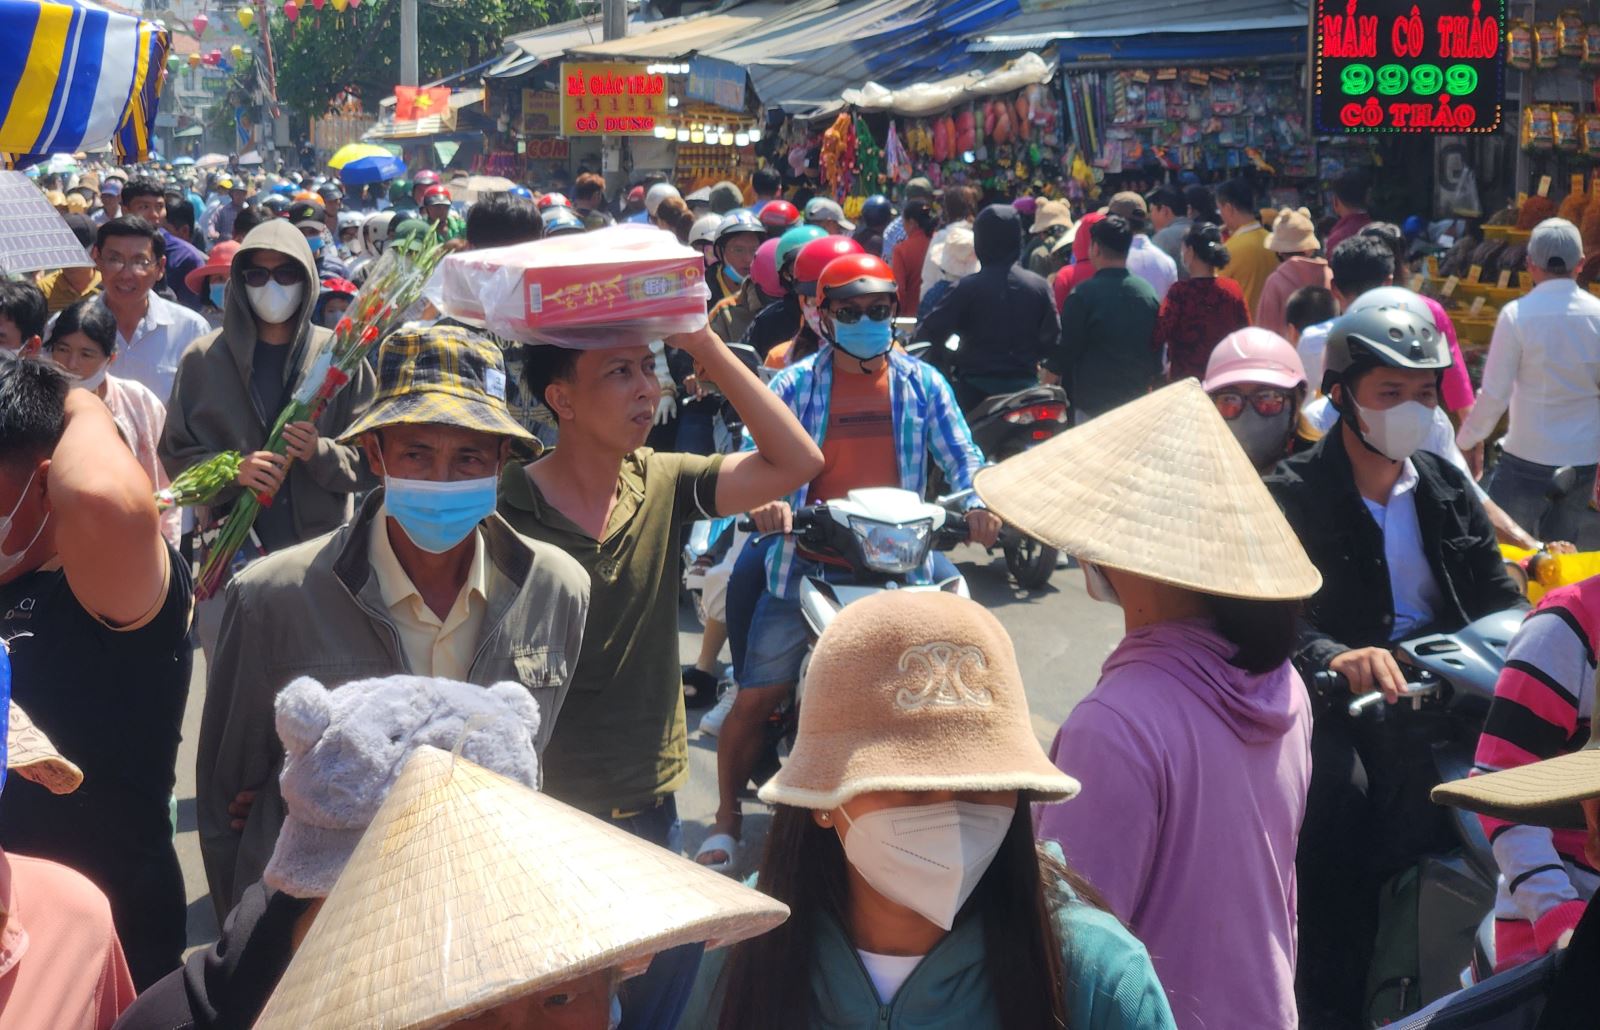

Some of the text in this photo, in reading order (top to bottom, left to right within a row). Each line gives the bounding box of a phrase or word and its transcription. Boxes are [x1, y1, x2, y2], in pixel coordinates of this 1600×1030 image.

[1392, 4, 1424, 57] CÔ
[1438, 0, 1498, 58] THẢO
[1340, 63, 1478, 96] 9999
[1341, 93, 1476, 127] CÔ THẢO
